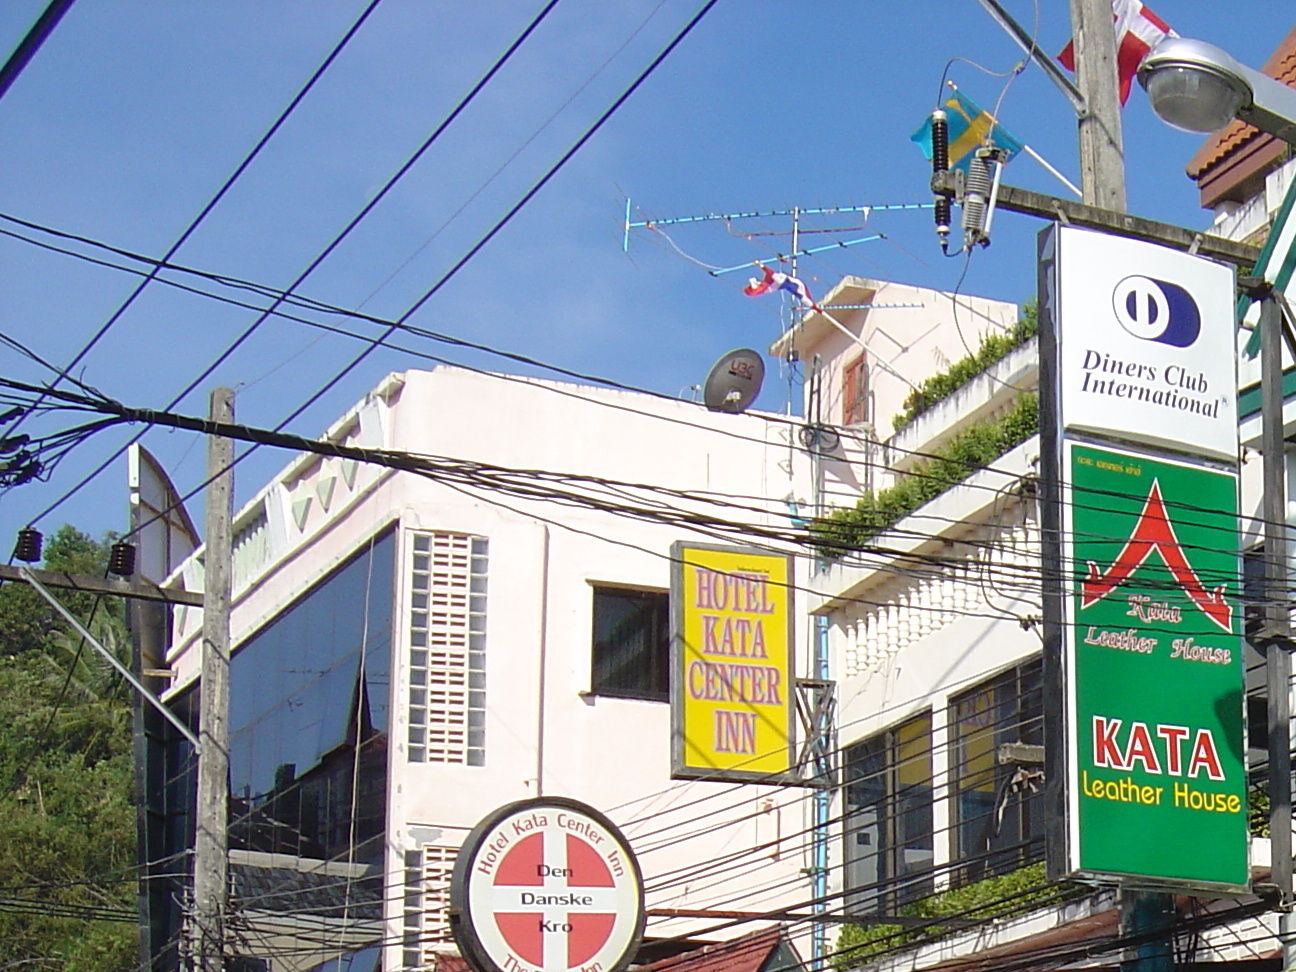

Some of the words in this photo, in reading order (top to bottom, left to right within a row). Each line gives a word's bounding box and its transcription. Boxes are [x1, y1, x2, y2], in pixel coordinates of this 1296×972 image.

[1081, 349, 1157, 382] Diners
[1164, 364, 1209, 395] Club
[695, 567, 774, 614] HOTEL
[1126, 593, 1182, 623] Kata
[702, 615, 768, 659] KATA
[1085, 625, 1157, 654] Leather
[1170, 638, 1231, 665] House
[688, 660, 782, 705] CENTER
[714, 709, 757, 755] INN
[1092, 715, 1226, 781] KATA
[1082, 770, 1164, 806] Leather
[1174, 782, 1242, 814] House
[477, 831, 509, 876] Hotel
[511, 814, 548, 835] Kata
[556, 813, 605, 845] Center
[607, 850, 625, 878] Inn
[537, 864, 573, 878] Den
[521, 892, 593, 906] Danske
[538, 920, 573, 933] Kro
